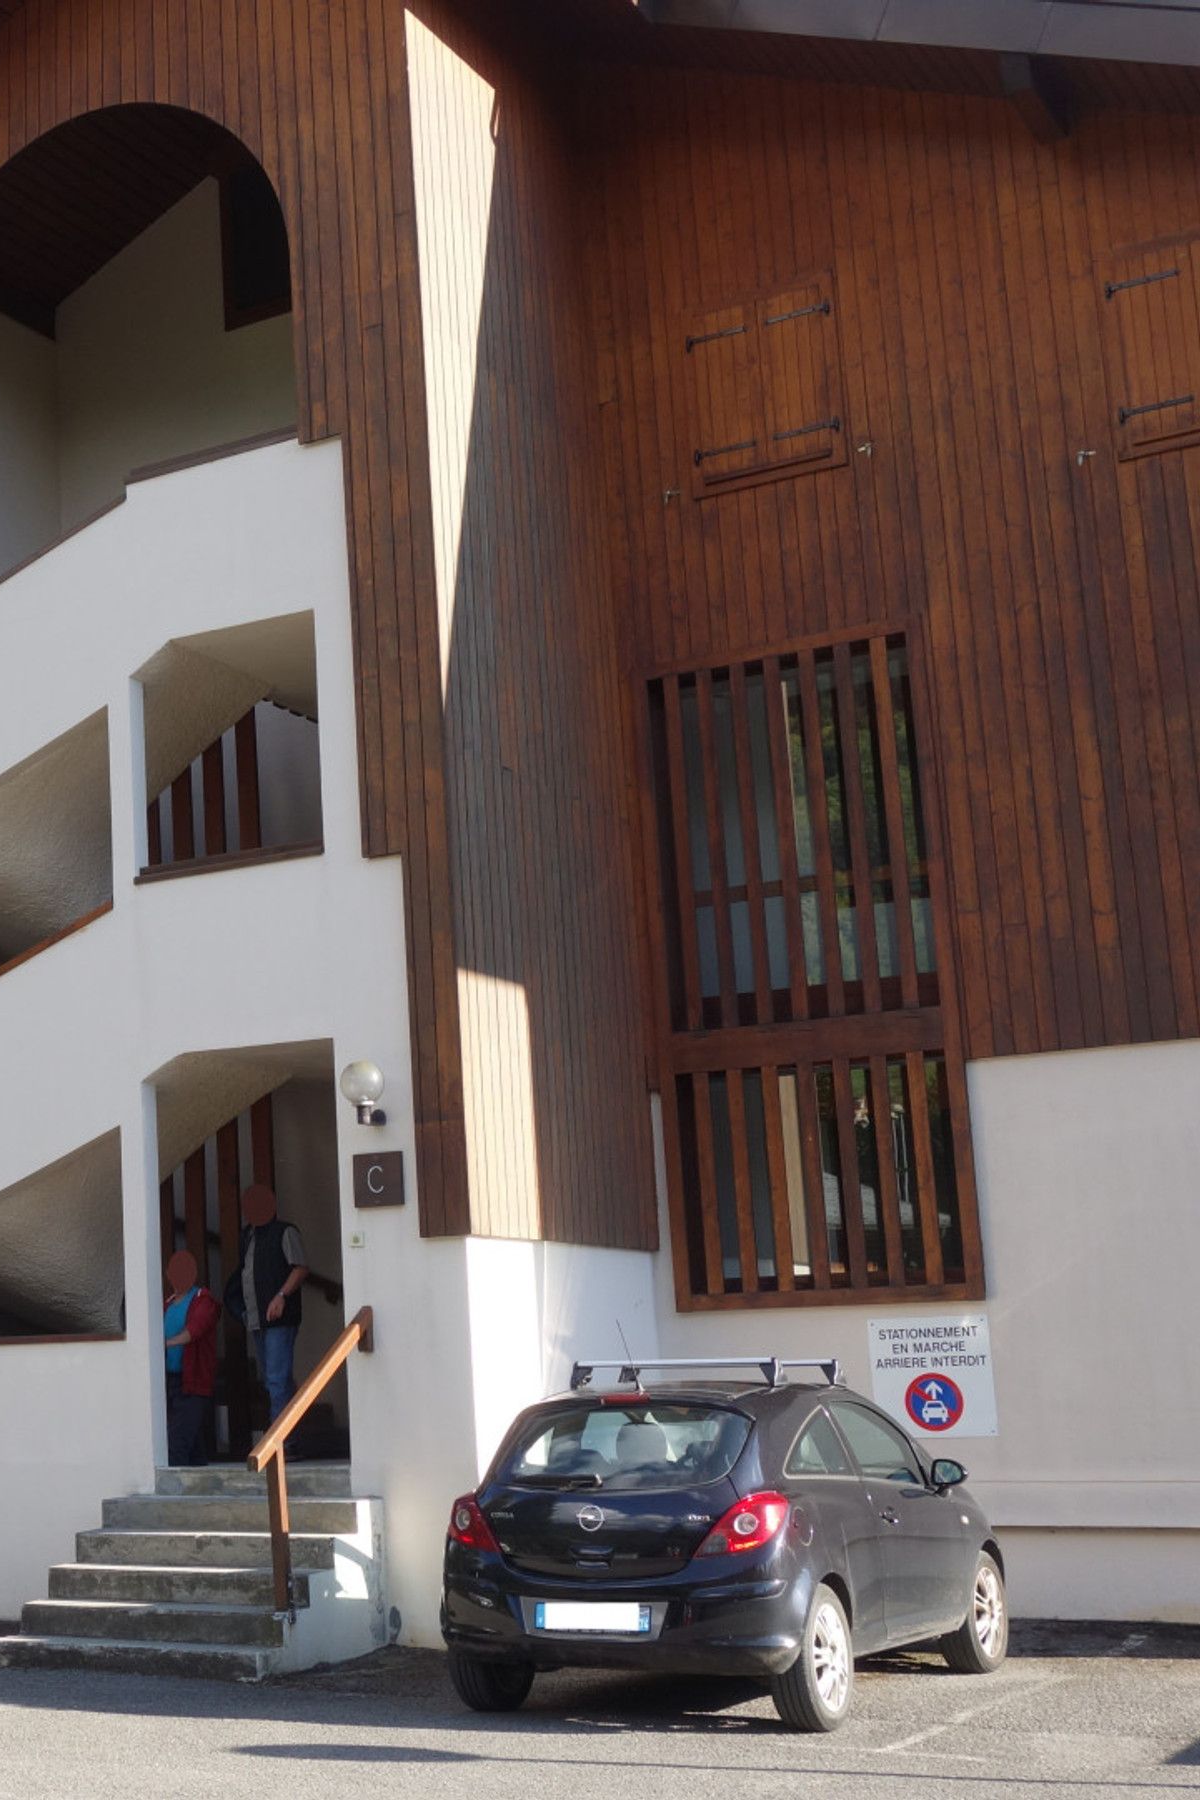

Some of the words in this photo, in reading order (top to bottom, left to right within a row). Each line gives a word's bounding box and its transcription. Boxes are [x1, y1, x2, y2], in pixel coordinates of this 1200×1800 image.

[367, 1165, 384, 1194] C
[878, 1326, 978, 1341] STATIONNEMENT
[892, 1343, 909, 1355] EN
[913, 1340, 967, 1354] MARCHE
[876, 1357, 928, 1369] ARRIERE
[930, 1355, 987, 1368] INTERDIT
